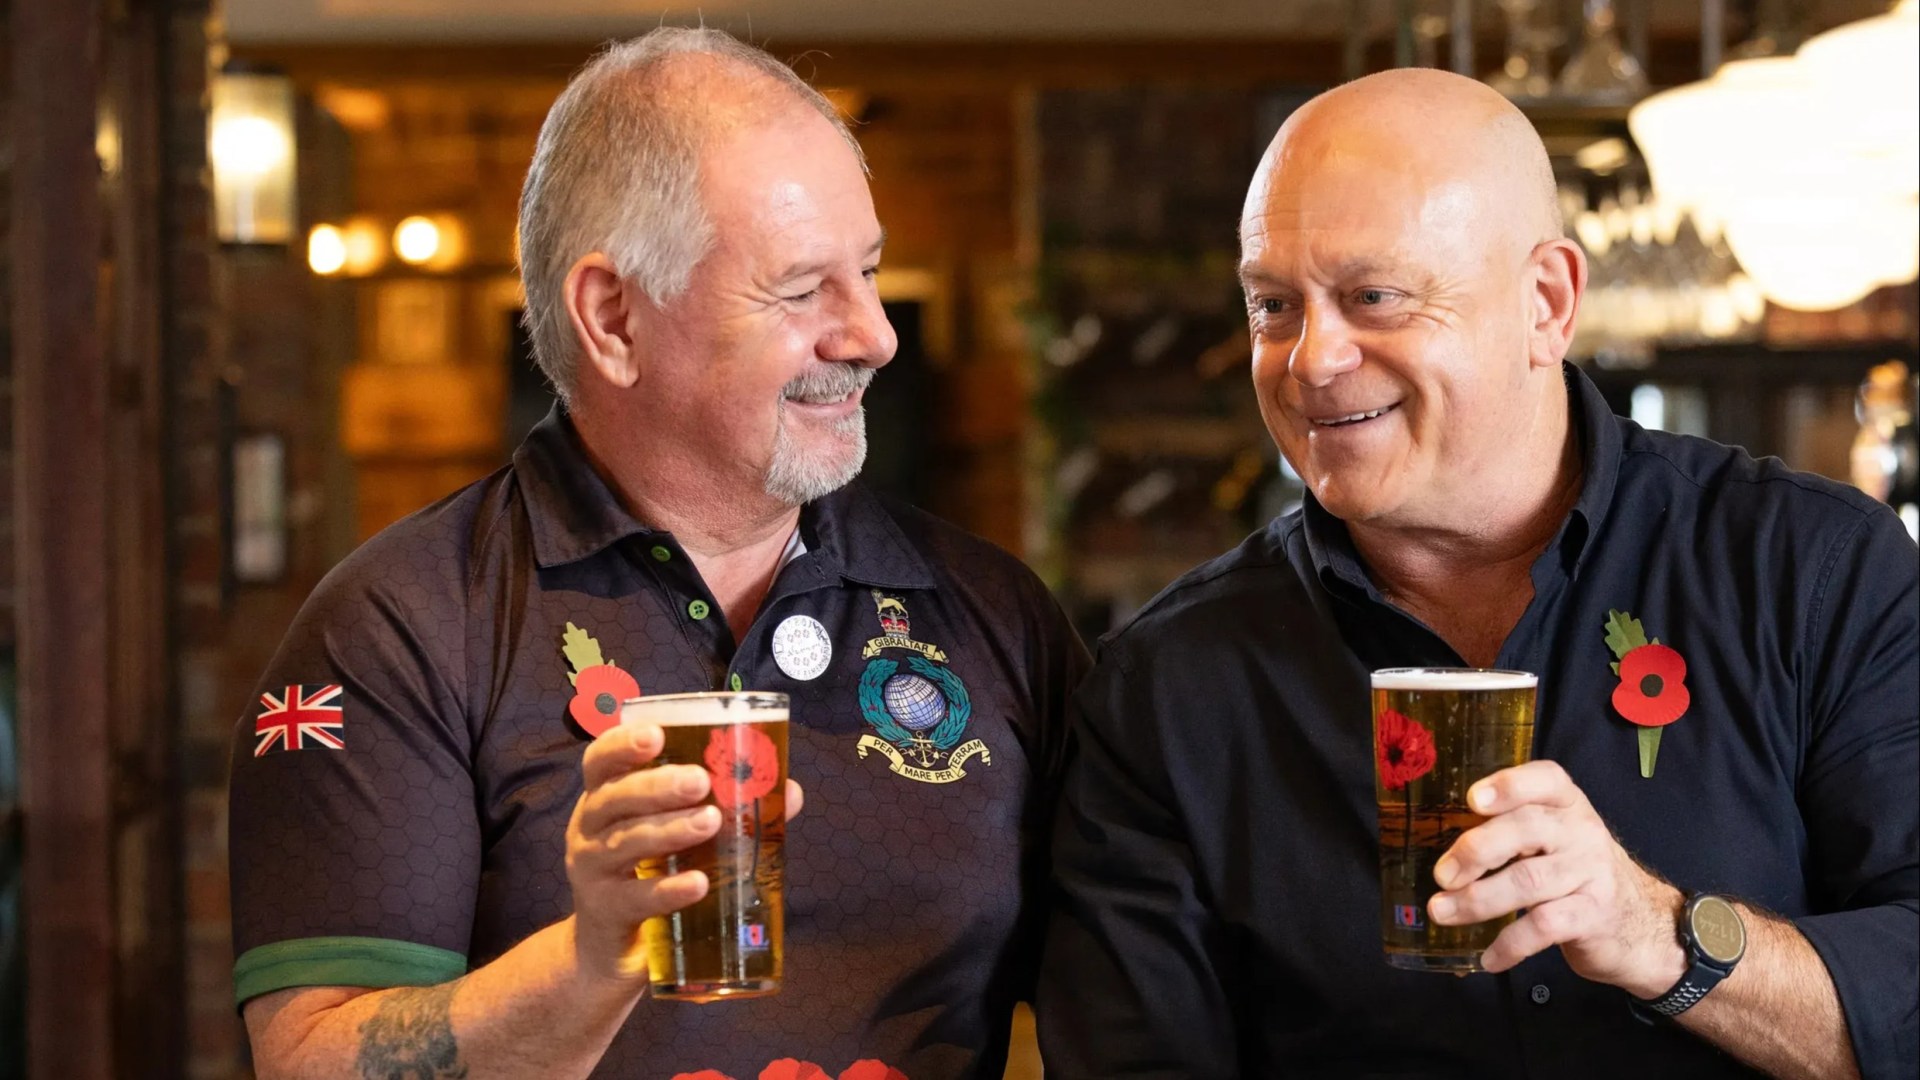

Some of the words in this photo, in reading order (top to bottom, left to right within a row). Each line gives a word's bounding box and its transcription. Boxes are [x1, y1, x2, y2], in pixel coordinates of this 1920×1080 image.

[874, 638, 929, 652] GIBRALTAR
[873, 739, 894, 757] PER
[904, 766, 932, 781] MARE
[935, 770, 954, 781] PER
[950, 740, 983, 769] TERRAM
